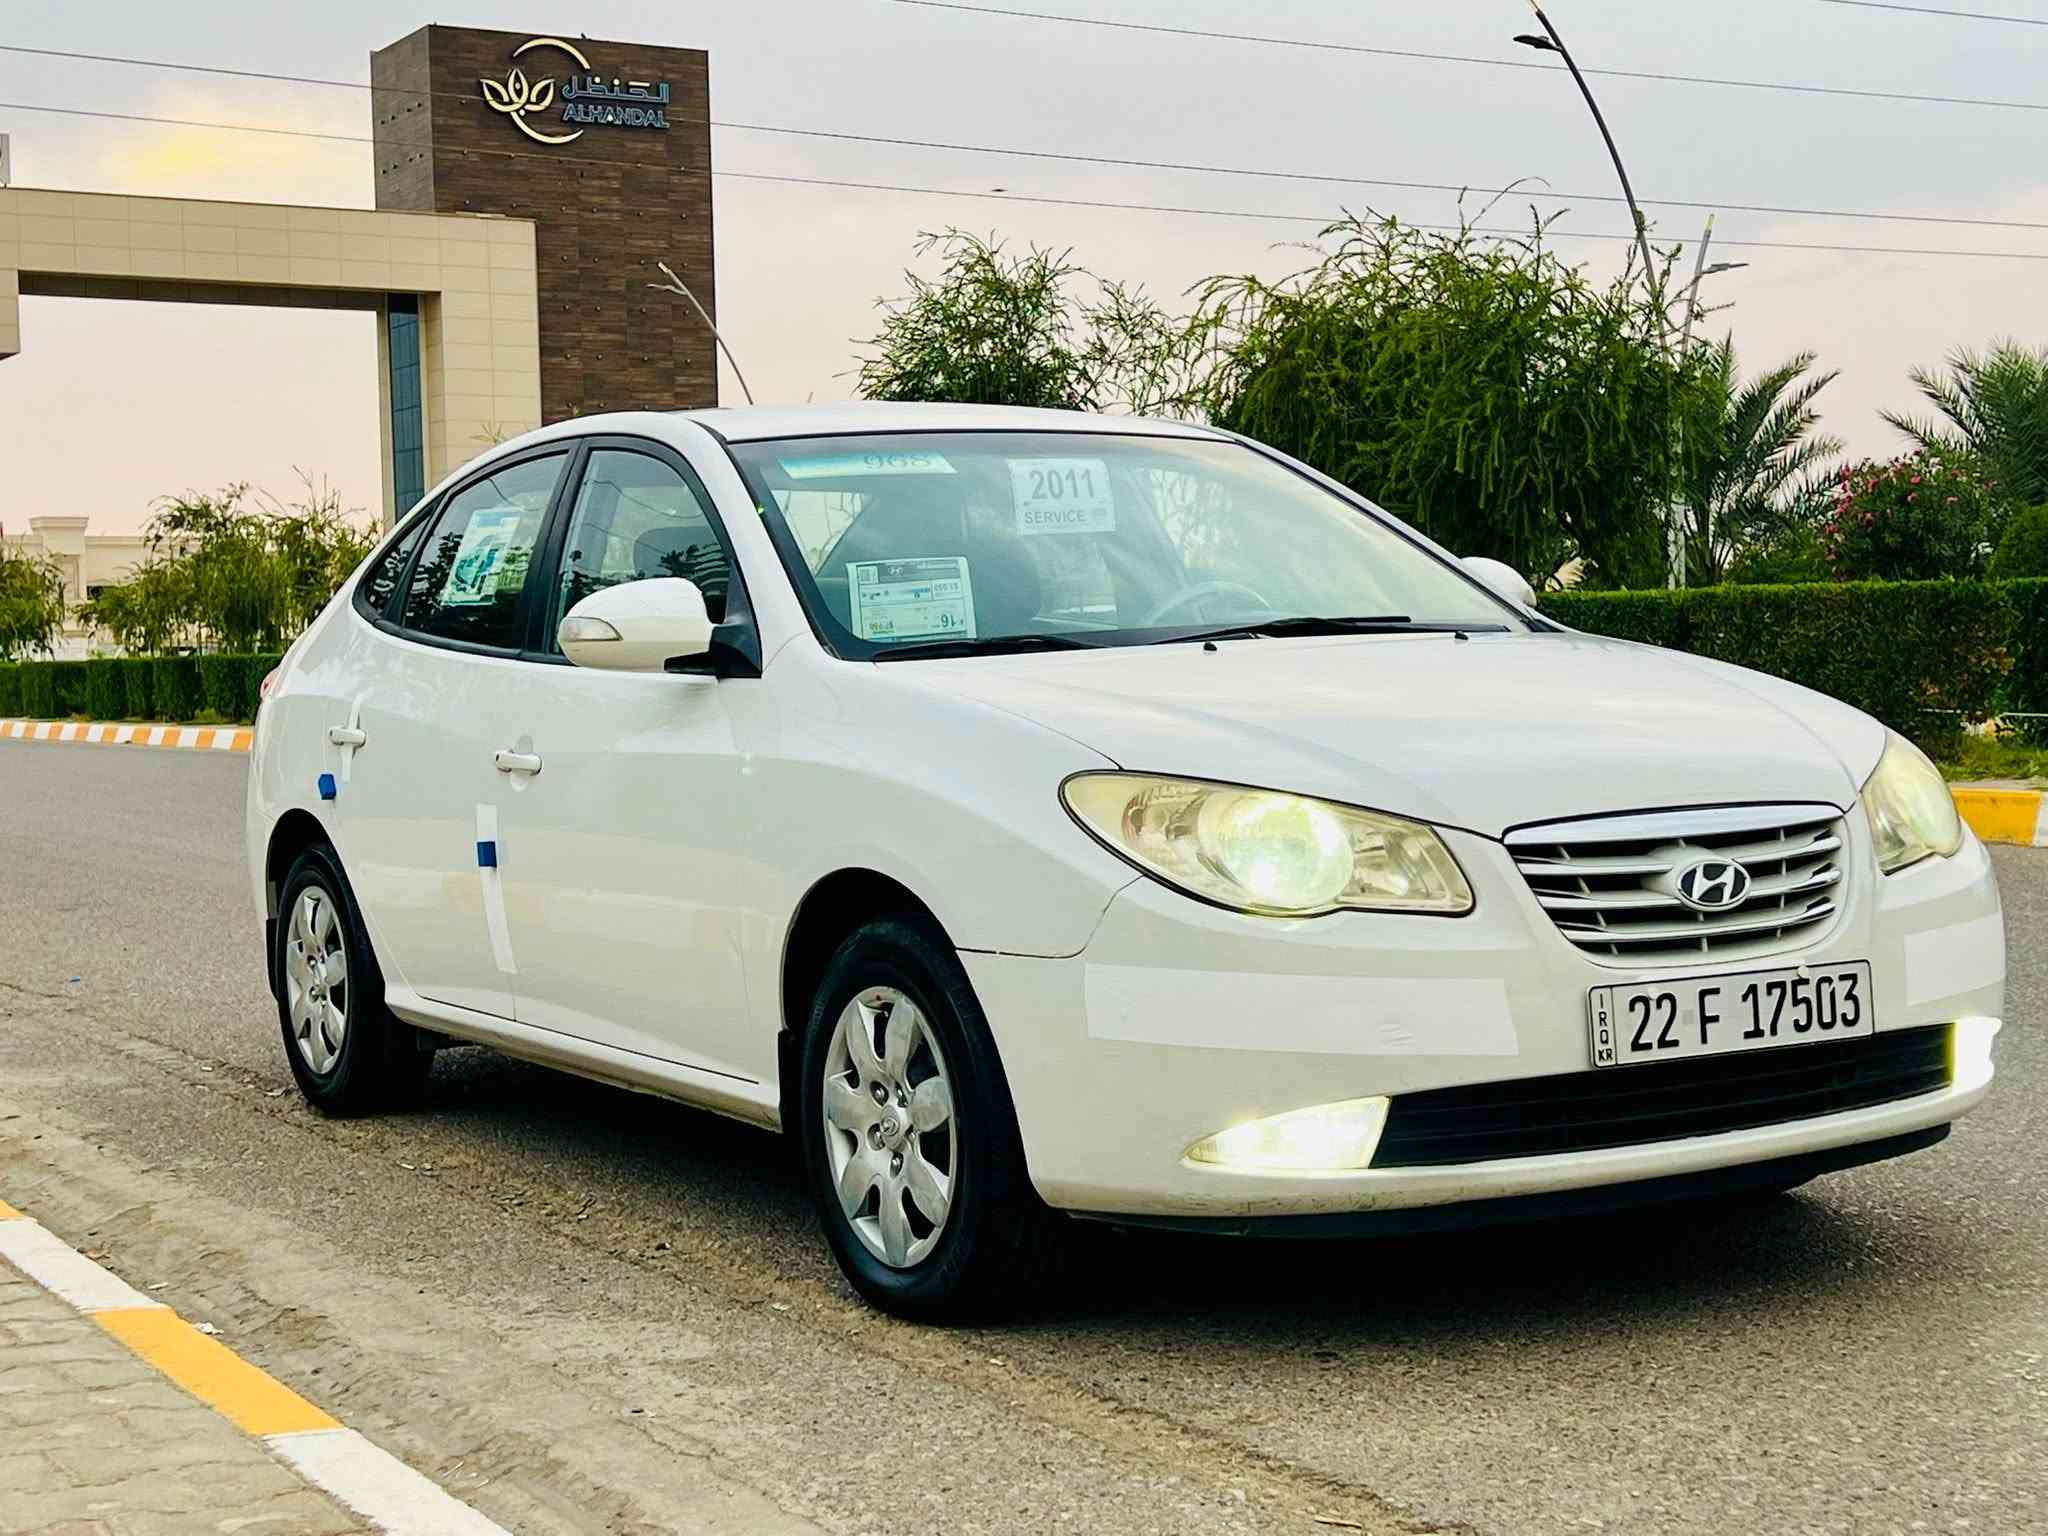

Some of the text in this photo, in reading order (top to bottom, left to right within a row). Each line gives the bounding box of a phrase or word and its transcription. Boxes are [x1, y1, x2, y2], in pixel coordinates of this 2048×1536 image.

[562, 103, 670, 128] ALHANDAL
[1029, 468, 1095, 499] 2011
[1024, 510, 1087, 524] SERVICE
[1628, 972, 1861, 1052] 22 F 17503
[1598, 1048, 1614, 1062] KR
